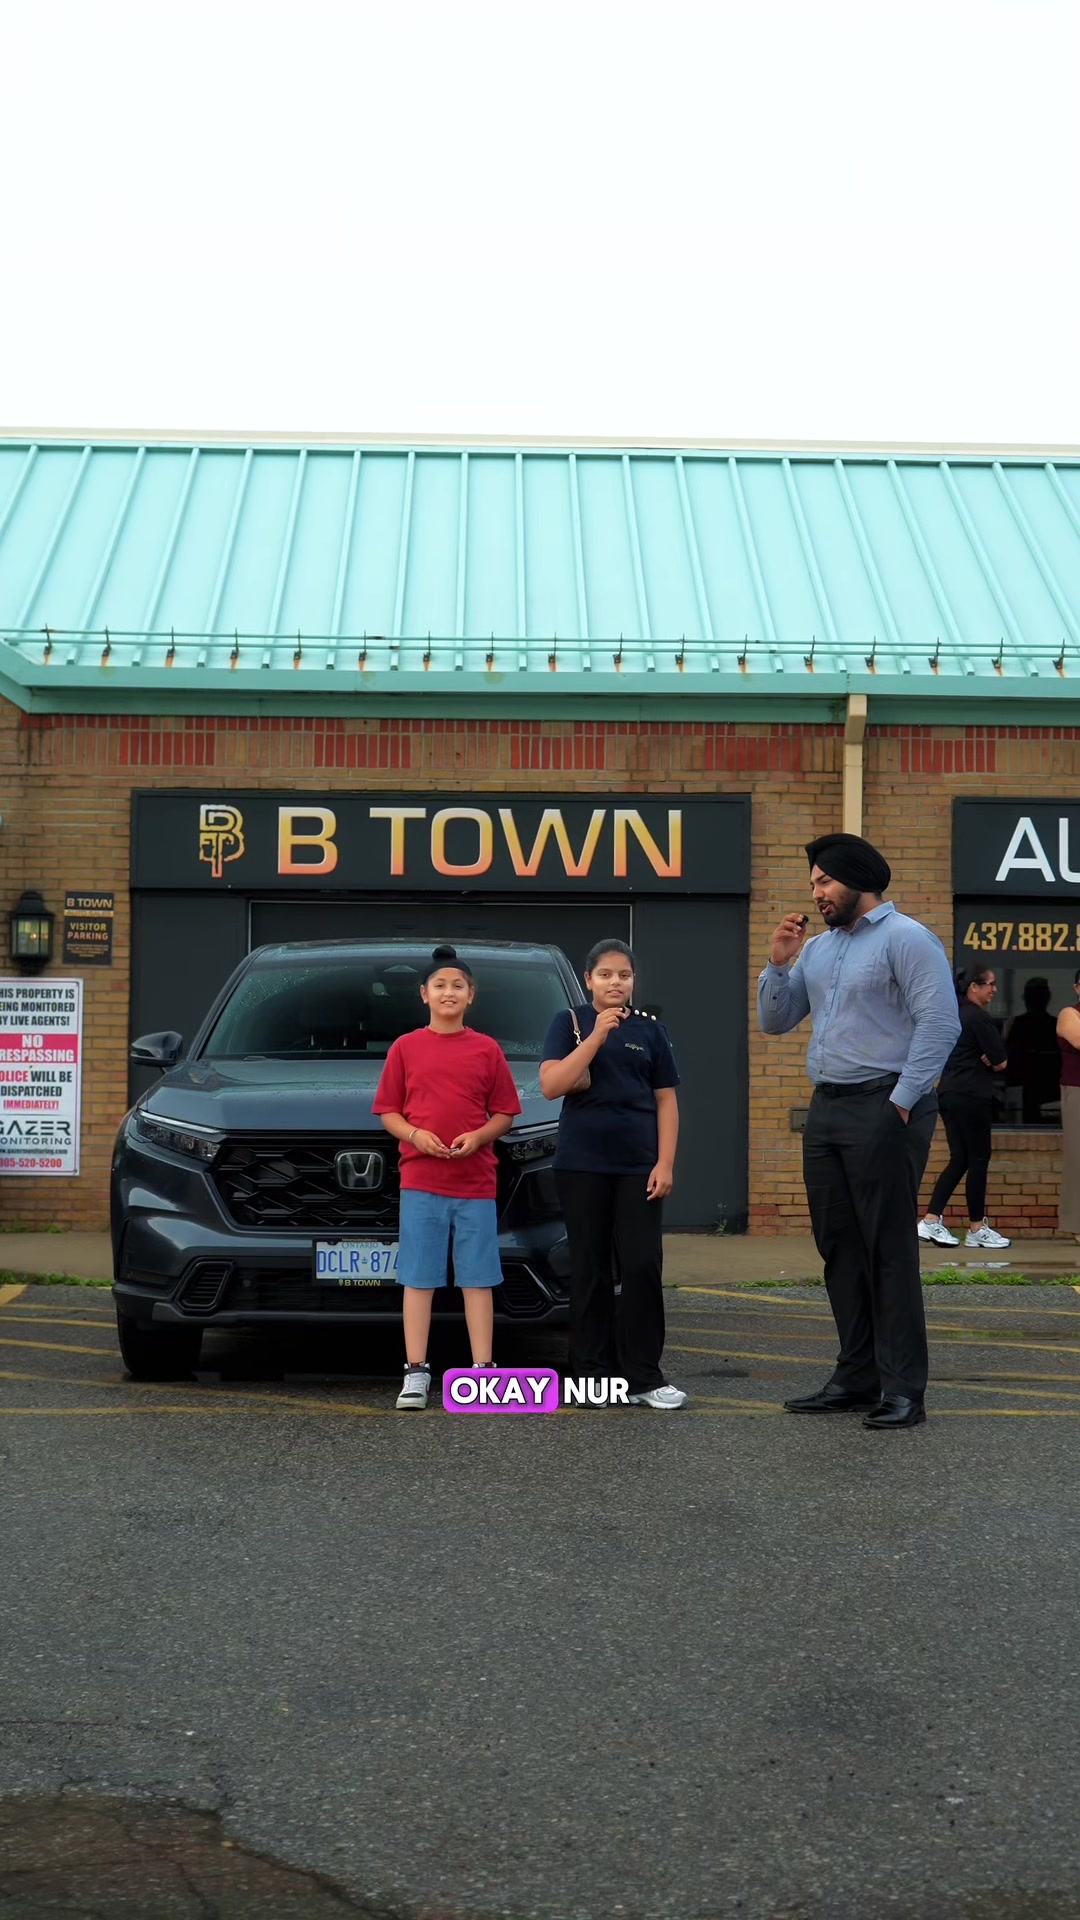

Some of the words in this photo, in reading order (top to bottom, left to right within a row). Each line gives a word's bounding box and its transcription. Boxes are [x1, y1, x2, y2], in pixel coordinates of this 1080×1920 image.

[277, 806, 339, 875] B
[369, 807, 682, 877] TOWN
[66, 897, 75, 907] B
[77, 898, 112, 908] TOWN
[70, 922, 107, 931] VISITOR
[67, 931, 109, 940] PARKING
[16, 988, 63, 999] PROPERTY
[65, 989, 75, 999] IS
[21, 1002, 75, 1012] MONITORED
[10, 1015, 29, 1026] LIVE
[30, 1016, 70, 1026] AGENTS!
[22, 1034, 44, 1048] NO
[31, 1071, 56, 1082] WILL
[59, 1071, 72, 1082] BE
[1, 1085, 62, 1097] DISPATCHED
[3, 1100, 60, 1110] IMMEDIATELY!
[317, 1250, 359, 1273] DCLR
